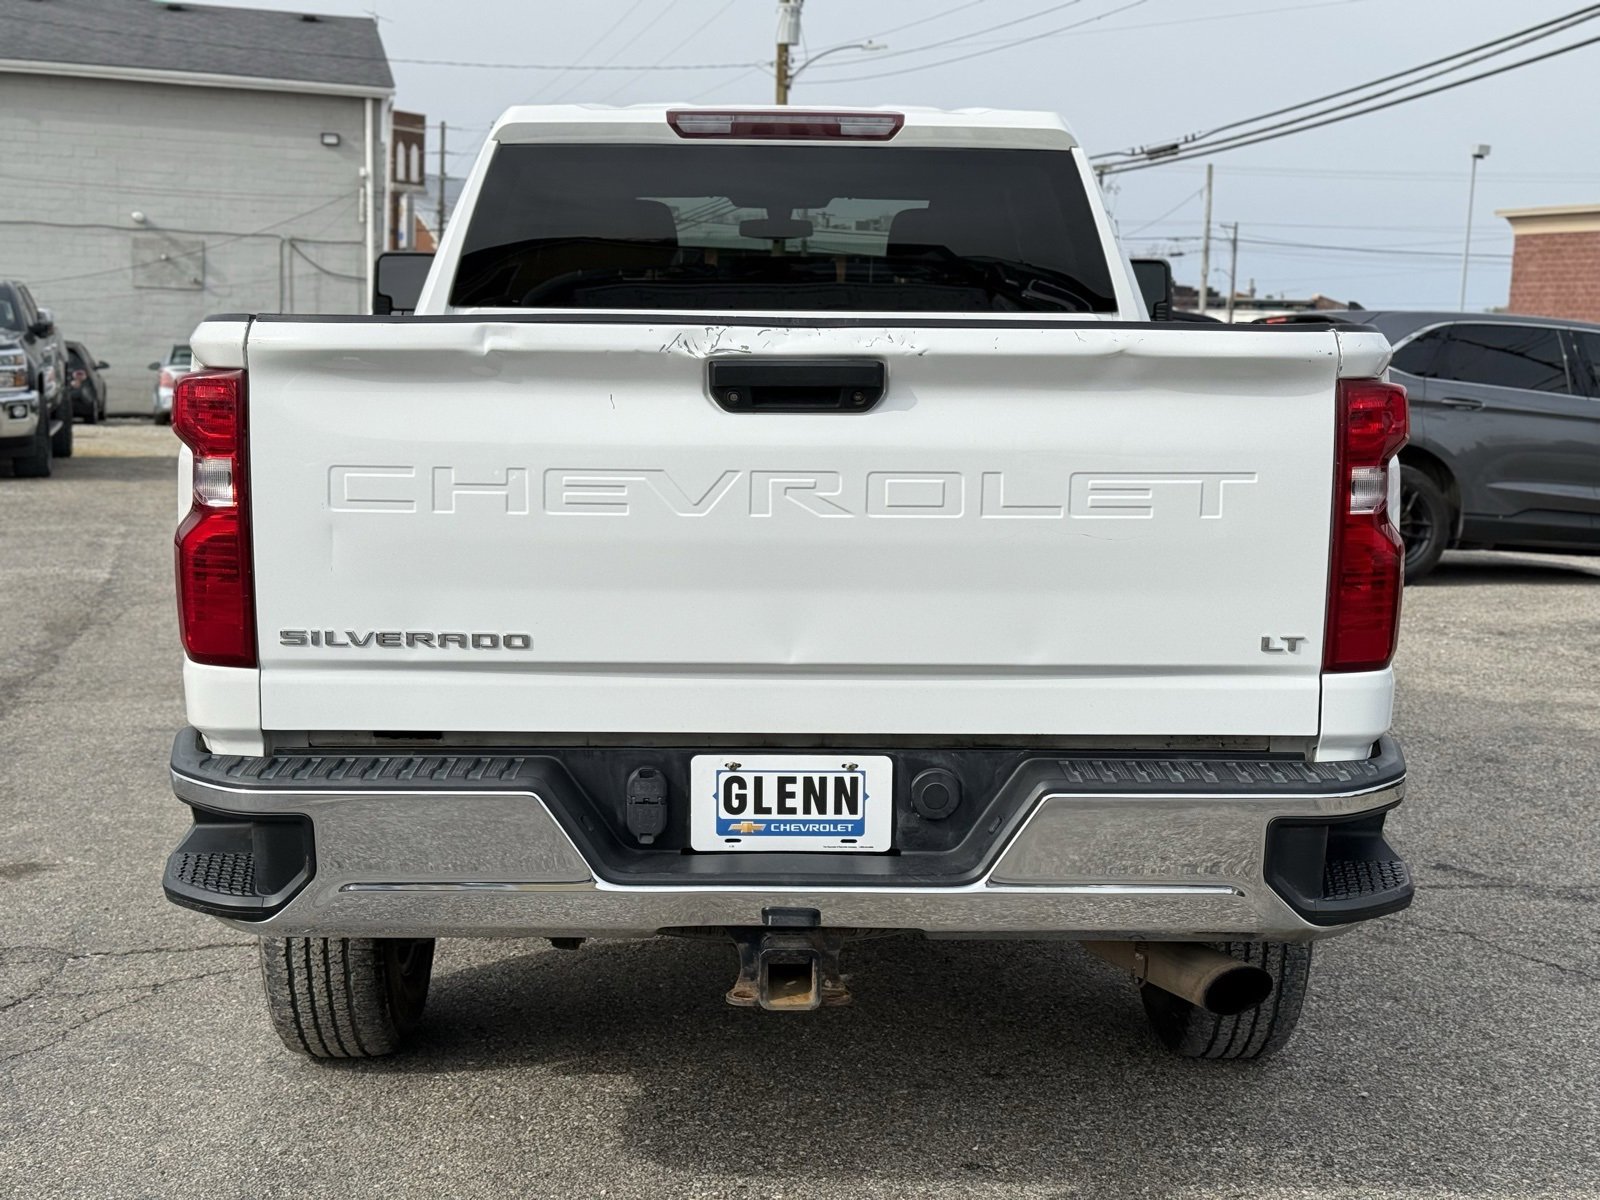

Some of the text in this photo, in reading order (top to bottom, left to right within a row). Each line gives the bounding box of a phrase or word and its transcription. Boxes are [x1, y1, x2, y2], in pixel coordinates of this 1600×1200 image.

[327, 464, 1259, 520] CHEVROLET
[279, 629, 533, 650] SILVERADO
[1260, 635, 1306, 653] LT
[722, 774, 860, 816] GLENN
[770, 822, 855, 833] CHEVROLET
